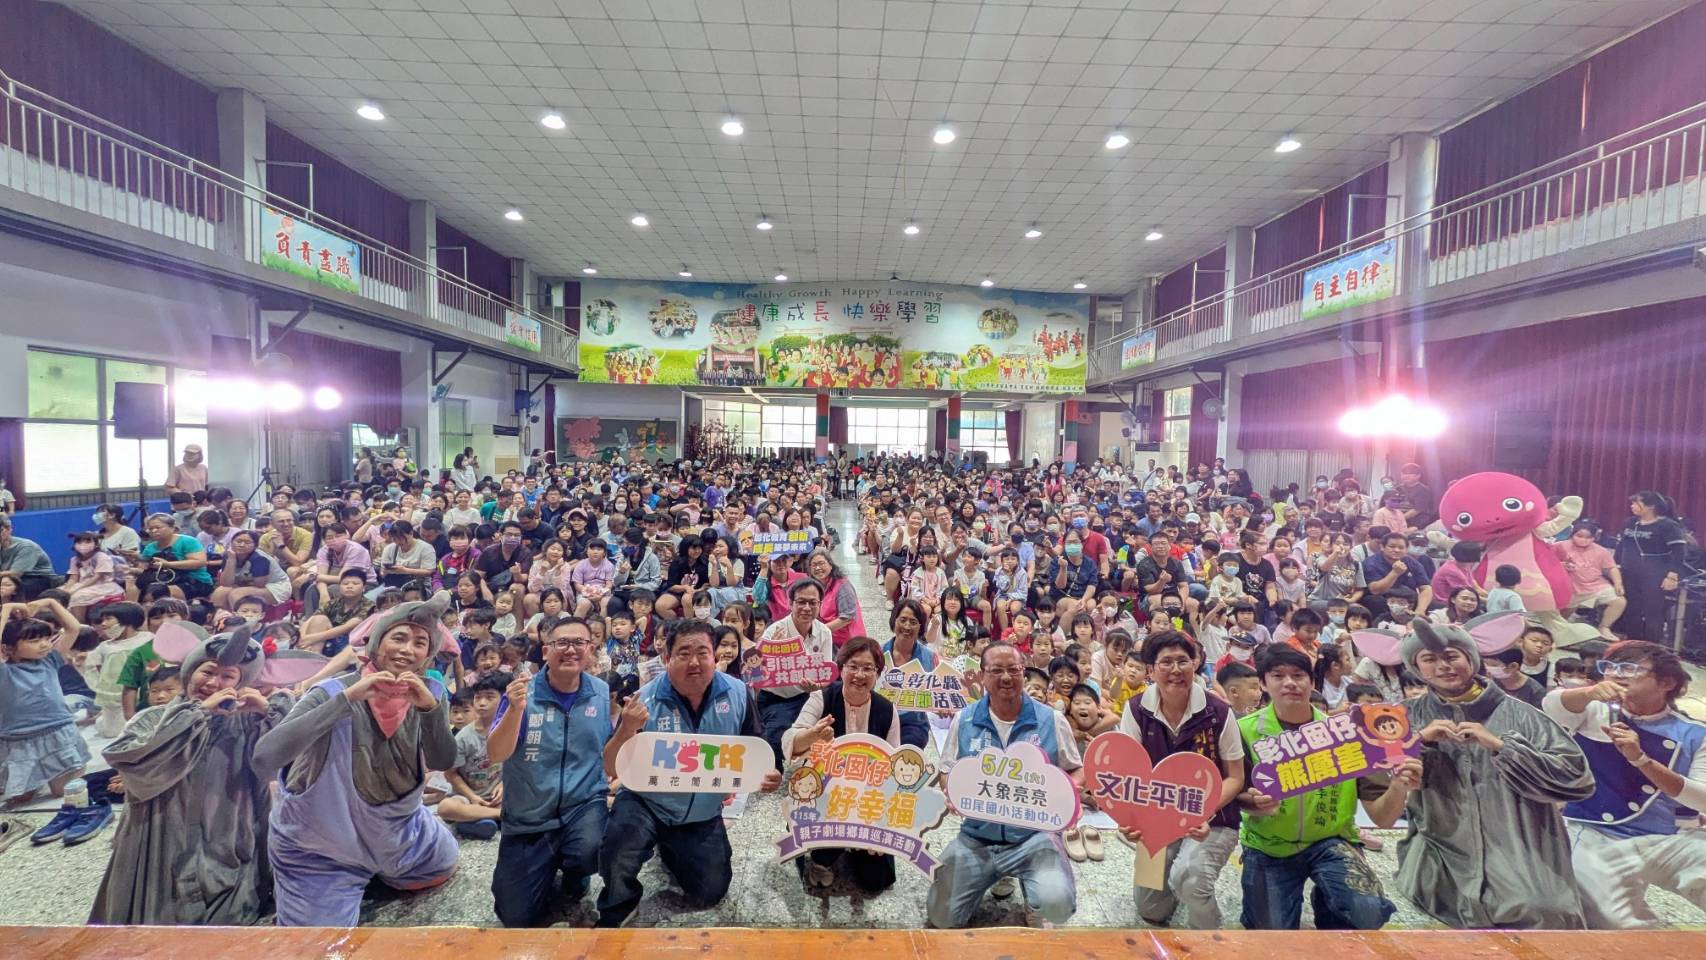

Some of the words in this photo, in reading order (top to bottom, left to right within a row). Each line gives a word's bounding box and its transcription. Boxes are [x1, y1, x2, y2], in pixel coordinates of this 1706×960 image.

[276, 231, 352, 280] 負責盡職
[736, 288, 782, 300] Healthy
[788, 288, 832, 298] Growth
[842, 287, 881, 299] Happy
[888, 288, 944, 301] Learning
[1312, 261, 1381, 302] 自主自律
[736, 300, 830, 323] 健康成長
[843, 300, 942, 324] 快樂學習
[908, 673, 962, 690] 彰化縣
[1275, 741, 1369, 793] 熊厲害
[825, 784, 919, 829] 好幸福
[977, 779, 1048, 807] 大象亮亮
[1094, 772, 1206, 816] 文化平權
[960, 797, 1063, 826] 田尾國小活動中心
[799, 824, 916, 854] 親子劇場鄉鎮巡演活動
